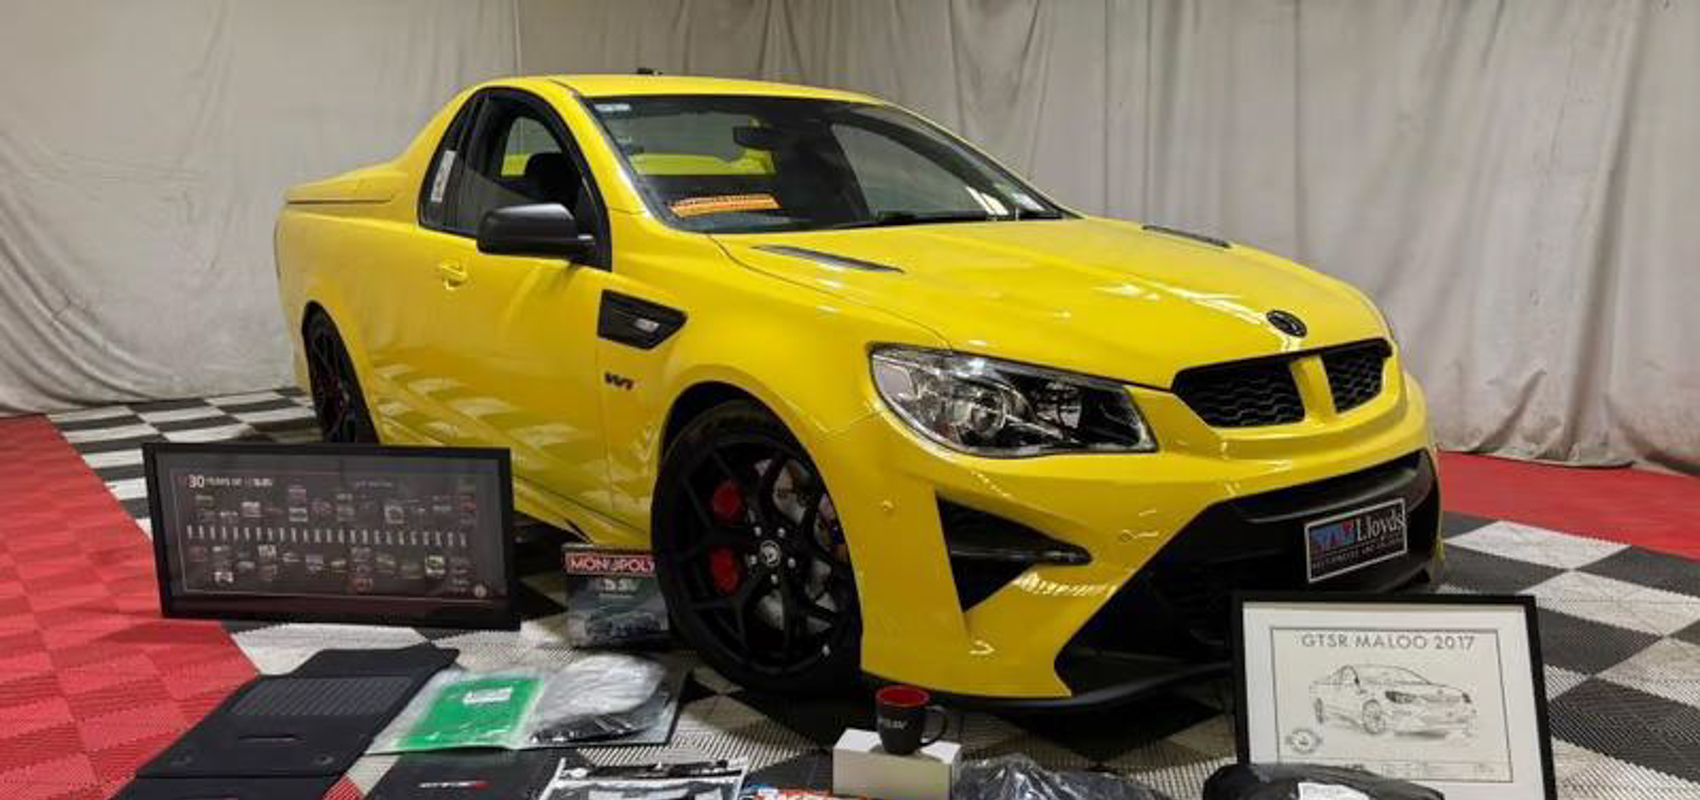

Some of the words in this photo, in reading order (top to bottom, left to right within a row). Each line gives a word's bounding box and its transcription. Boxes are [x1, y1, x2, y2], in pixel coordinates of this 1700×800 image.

[188, 474, 204, 488] 30
[1301, 633, 1348, 648] GTSR
[1354, 634, 1428, 649] MALOO
[1434, 635, 1475, 650] 2017
